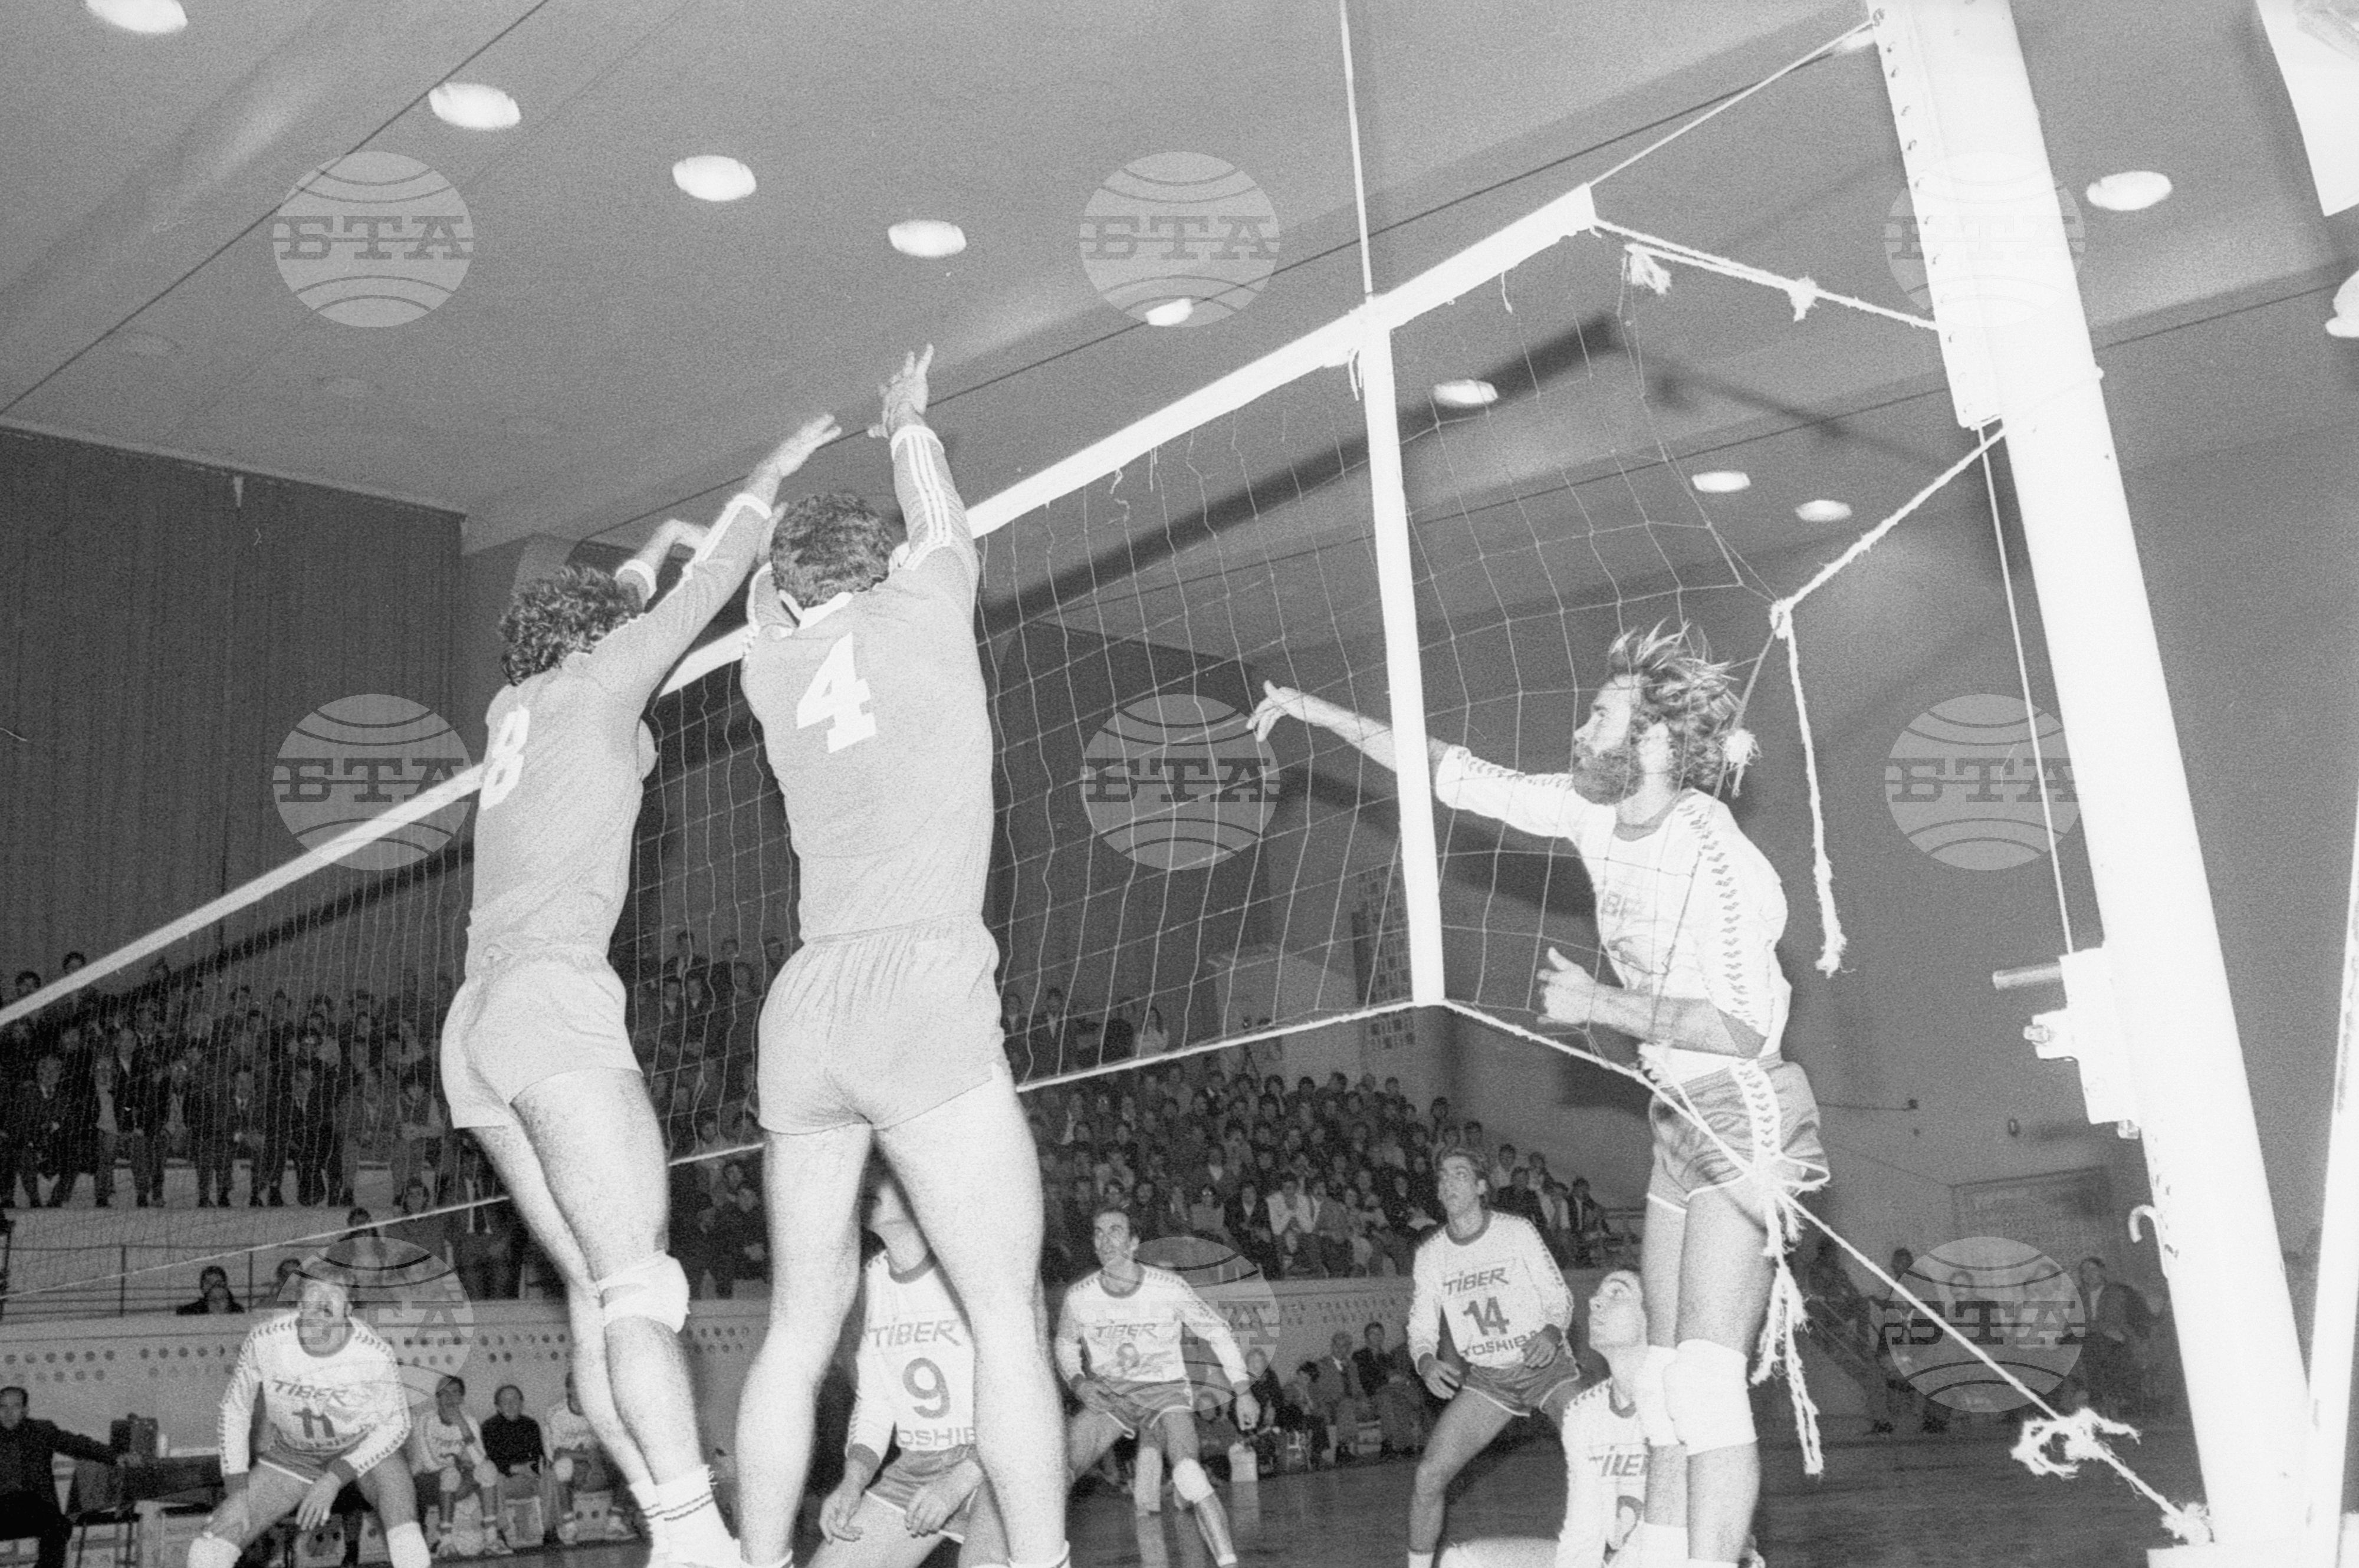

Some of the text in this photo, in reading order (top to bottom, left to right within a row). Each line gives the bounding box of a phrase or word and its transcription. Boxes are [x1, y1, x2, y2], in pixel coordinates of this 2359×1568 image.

[797, 632, 876, 754] 4
[479, 705, 530, 810] 8
[1463, 1297, 1509, 1336] 14
[902, 1357, 951, 1419] 9
[293, 1407, 335, 1438] 11
